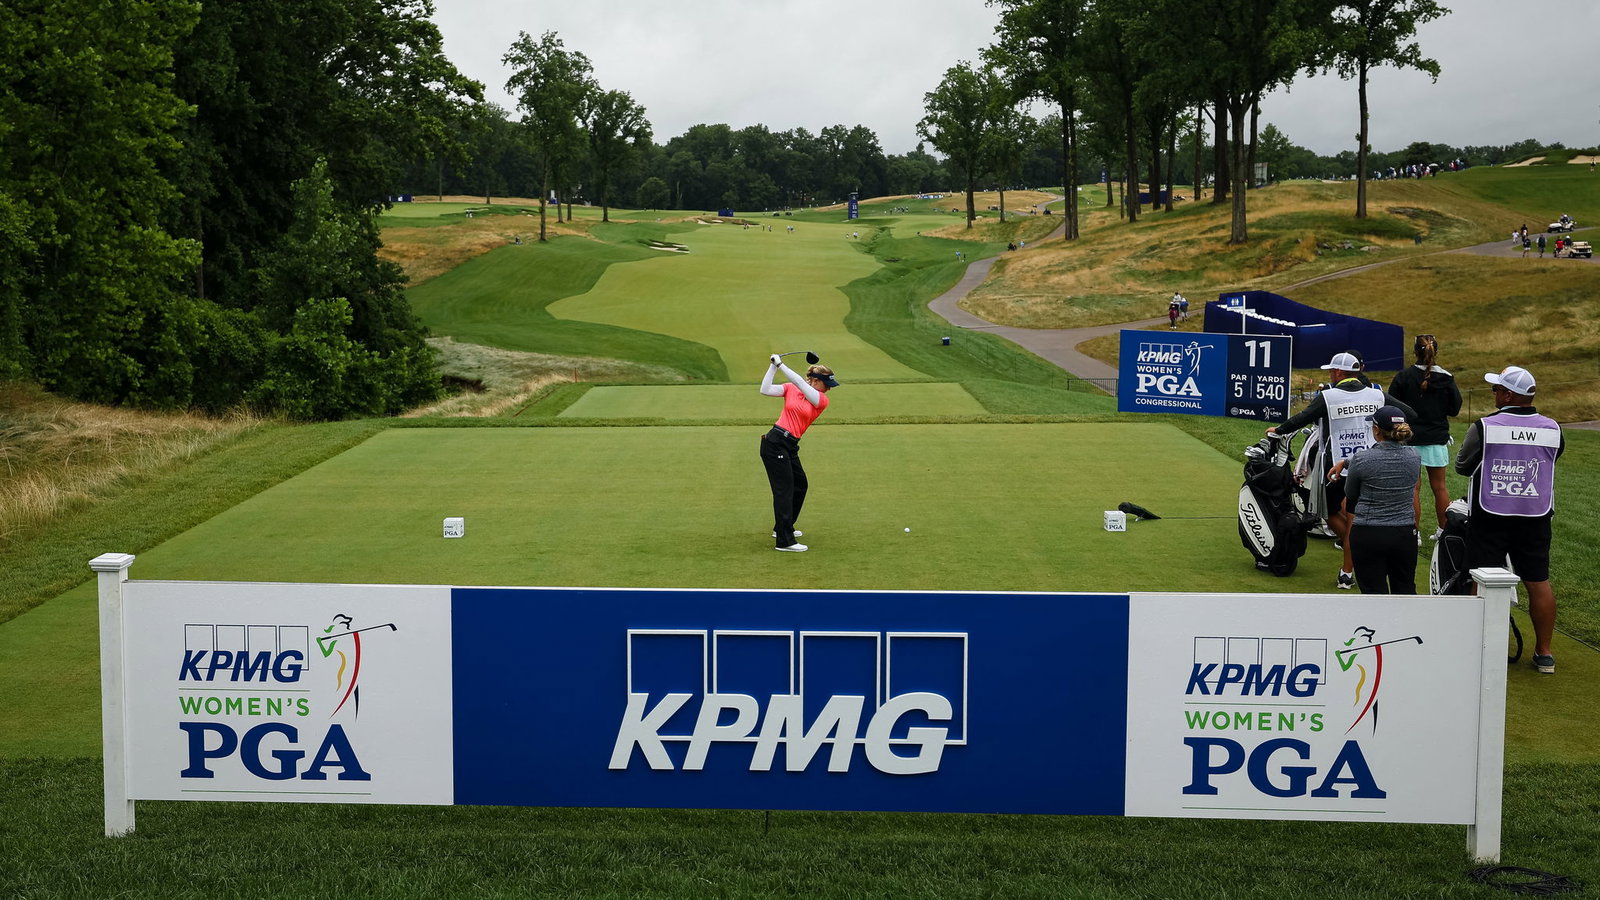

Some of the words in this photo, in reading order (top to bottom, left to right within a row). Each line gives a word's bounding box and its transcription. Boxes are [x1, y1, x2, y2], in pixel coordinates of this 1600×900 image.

[1137, 350, 1182, 364] KPMG
[1245, 340, 1271, 368] 11
[1137, 365, 1182, 374] WOMEN'S
[1231, 373, 1247, 381] PAR
[1136, 373, 1202, 397] PGA
[1257, 375, 1285, 383] YARDS
[1234, 382, 1243, 398] 5
[1256, 384, 1284, 400] 540
[1135, 398, 1202, 409] CONGRESSIONAL
[1337, 405, 1379, 415] PEDERSEN
[1239, 408, 1256, 416] PGA
[1339, 432, 1365, 441] KPMG
[1511, 430, 1537, 441] LAW
[1491, 464, 1526, 474] KPMG
[1490, 480, 1539, 497] PGA
[1240, 502, 1272, 553] Titleist
[178, 649, 304, 683] KPMG
[1185, 663, 1321, 698] KPMG
[178, 696, 310, 717] WOMEN'S
[1184, 710, 1324, 732] WOMEN'S
[608, 691, 953, 776] KPMG
[179, 721, 372, 781] PGA
[1182, 736, 1387, 799] PGA
